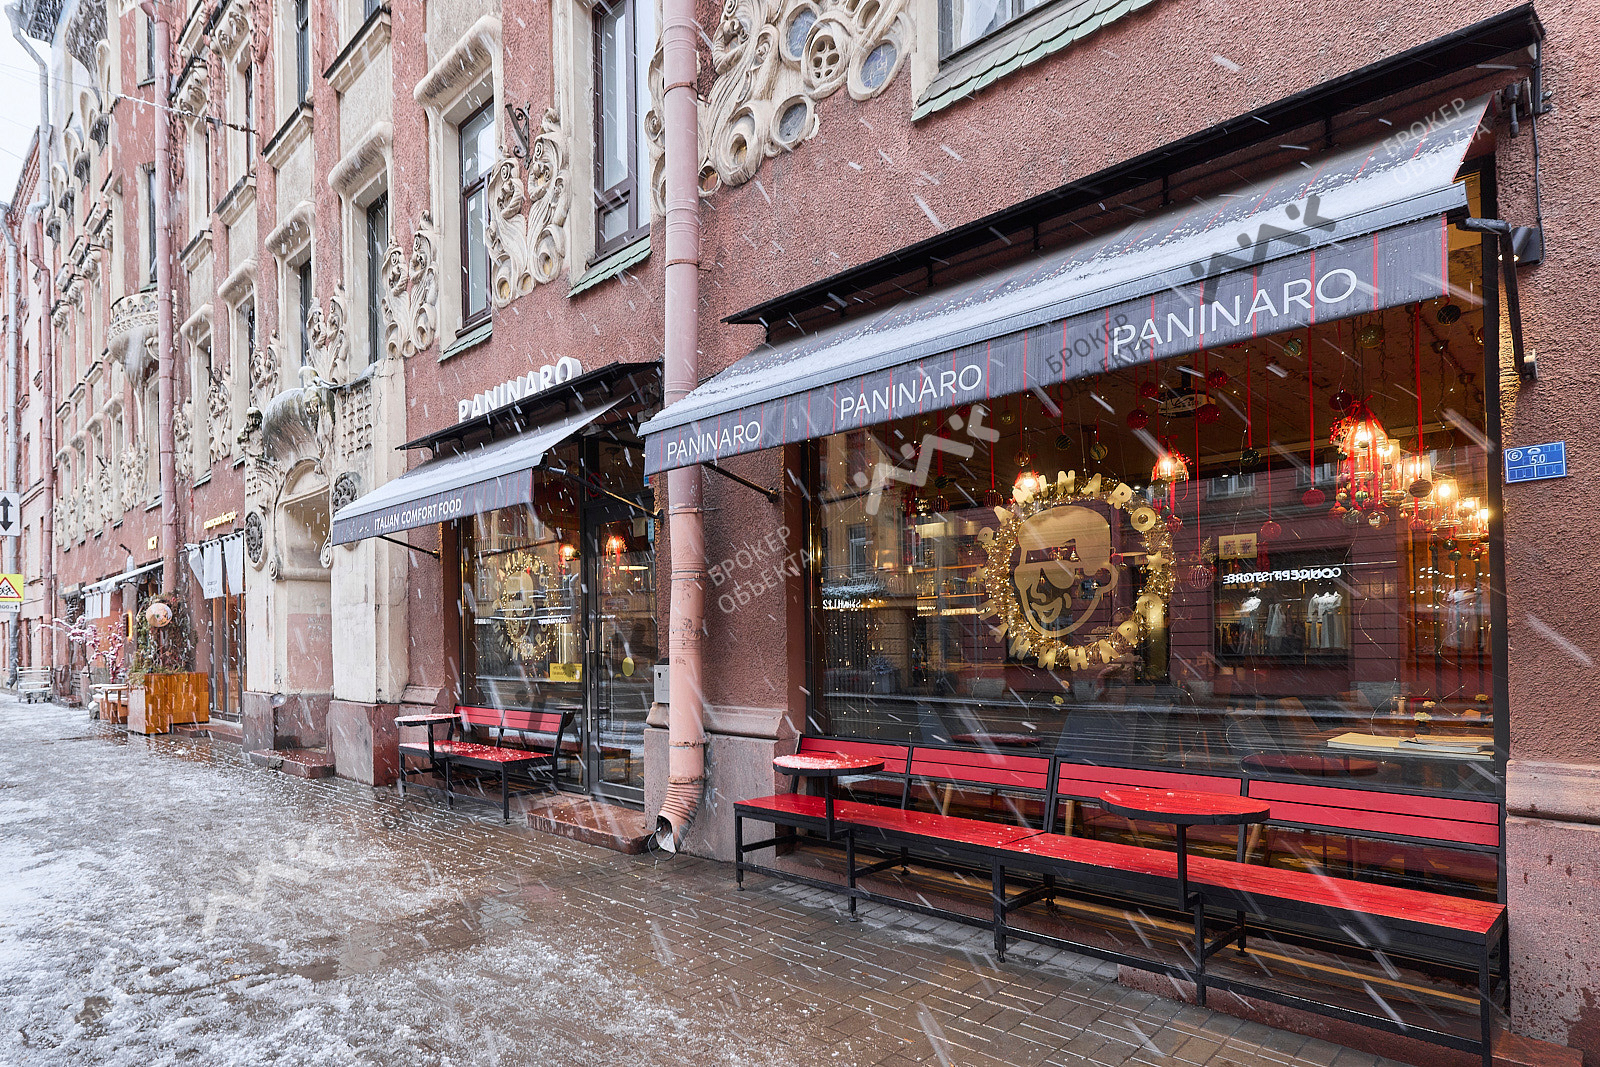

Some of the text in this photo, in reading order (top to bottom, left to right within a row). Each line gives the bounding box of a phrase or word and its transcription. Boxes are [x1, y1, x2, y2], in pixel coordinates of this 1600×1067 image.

[1113, 268, 1358, 356] PANINARO
[458, 356, 582, 424] PANINARO
[839, 364, 983, 421] PANINARO
[666, 421, 761, 461] PANINARO
[374, 498, 462, 531] ITALIAN COMFORT FOOD
